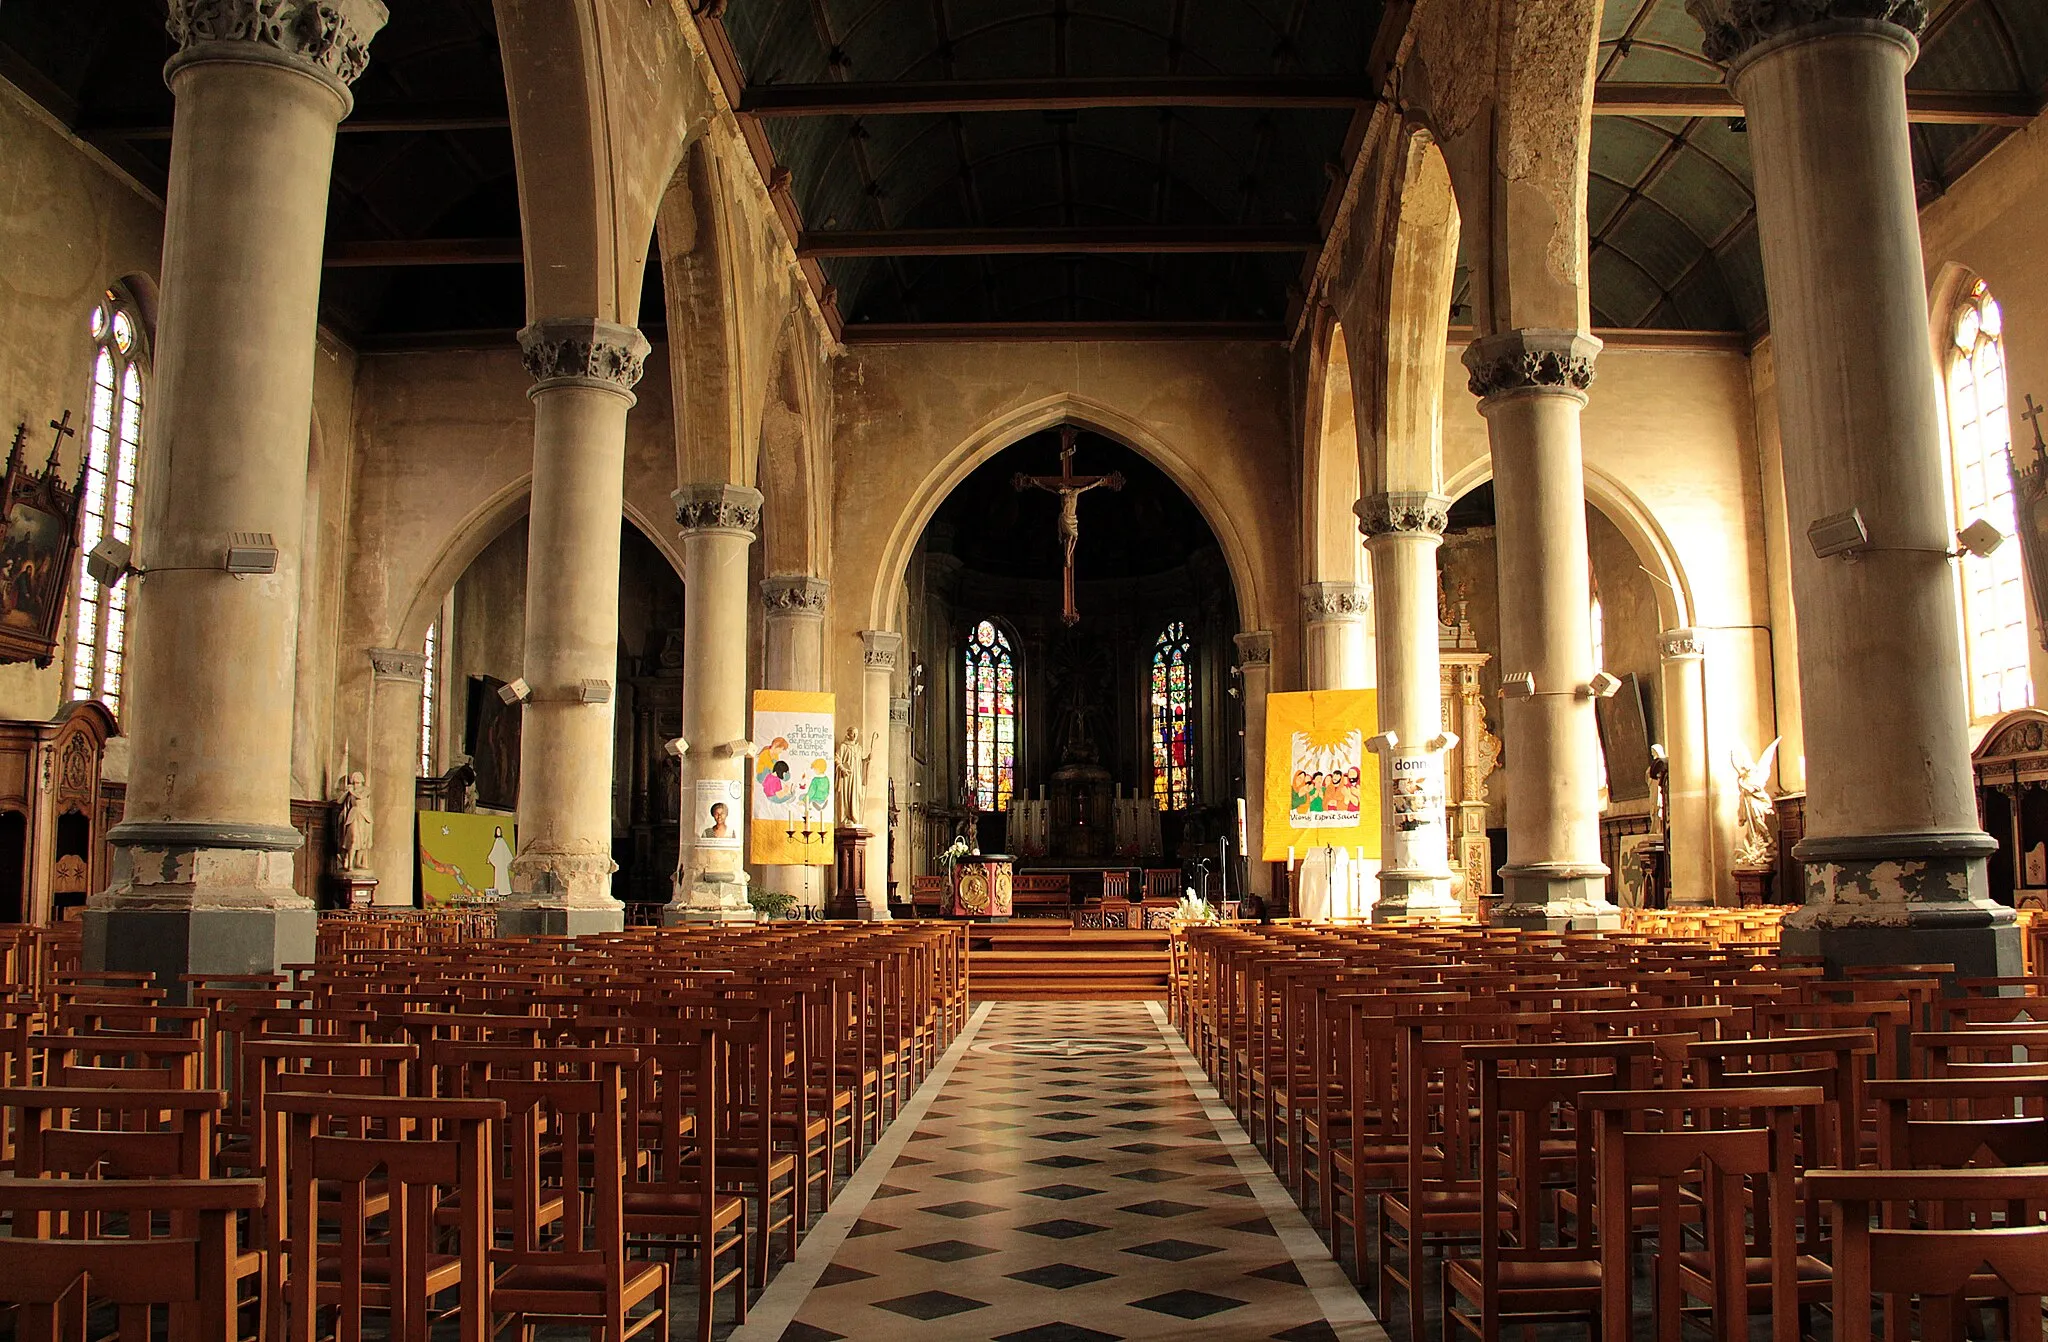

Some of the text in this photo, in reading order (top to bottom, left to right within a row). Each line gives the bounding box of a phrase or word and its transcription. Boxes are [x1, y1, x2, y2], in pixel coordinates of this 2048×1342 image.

[795, 723, 829, 733] Ta Parole
[1394, 758, 1430, 770] donn
